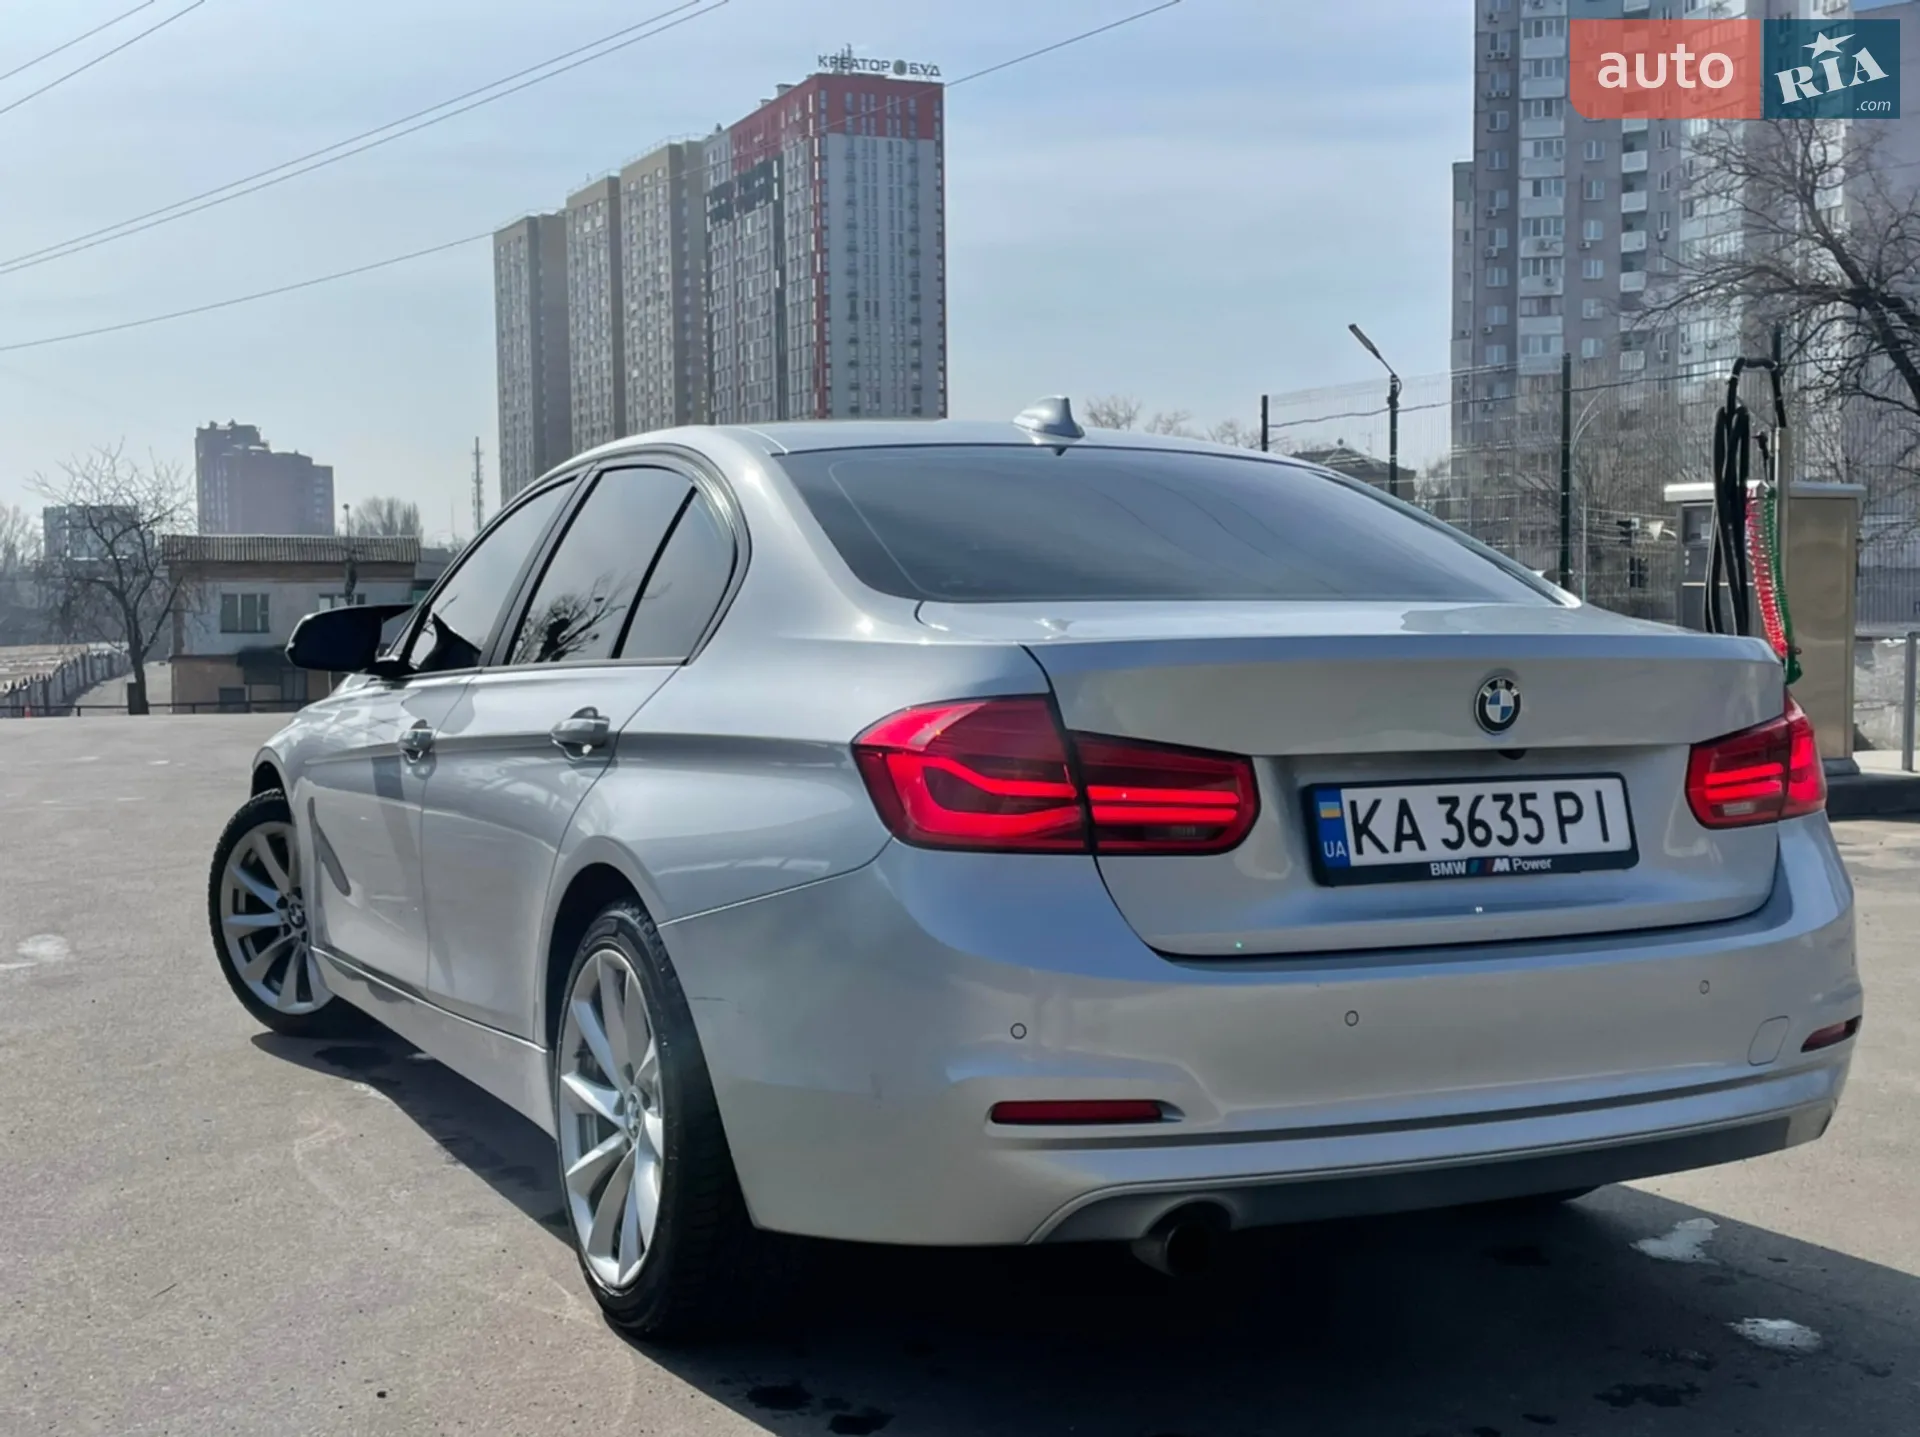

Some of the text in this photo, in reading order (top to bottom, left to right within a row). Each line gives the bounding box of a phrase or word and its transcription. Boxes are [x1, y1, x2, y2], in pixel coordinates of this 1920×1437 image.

[817, 54, 941, 76] КРЕАТОР БУД
[1349, 798, 1427, 856] KA
[1437, 792, 1545, 850] 3635
[1323, 840, 1347, 857] UA
[1430, 860, 1467, 876] BMW
[1512, 858, 1552, 871] Power
